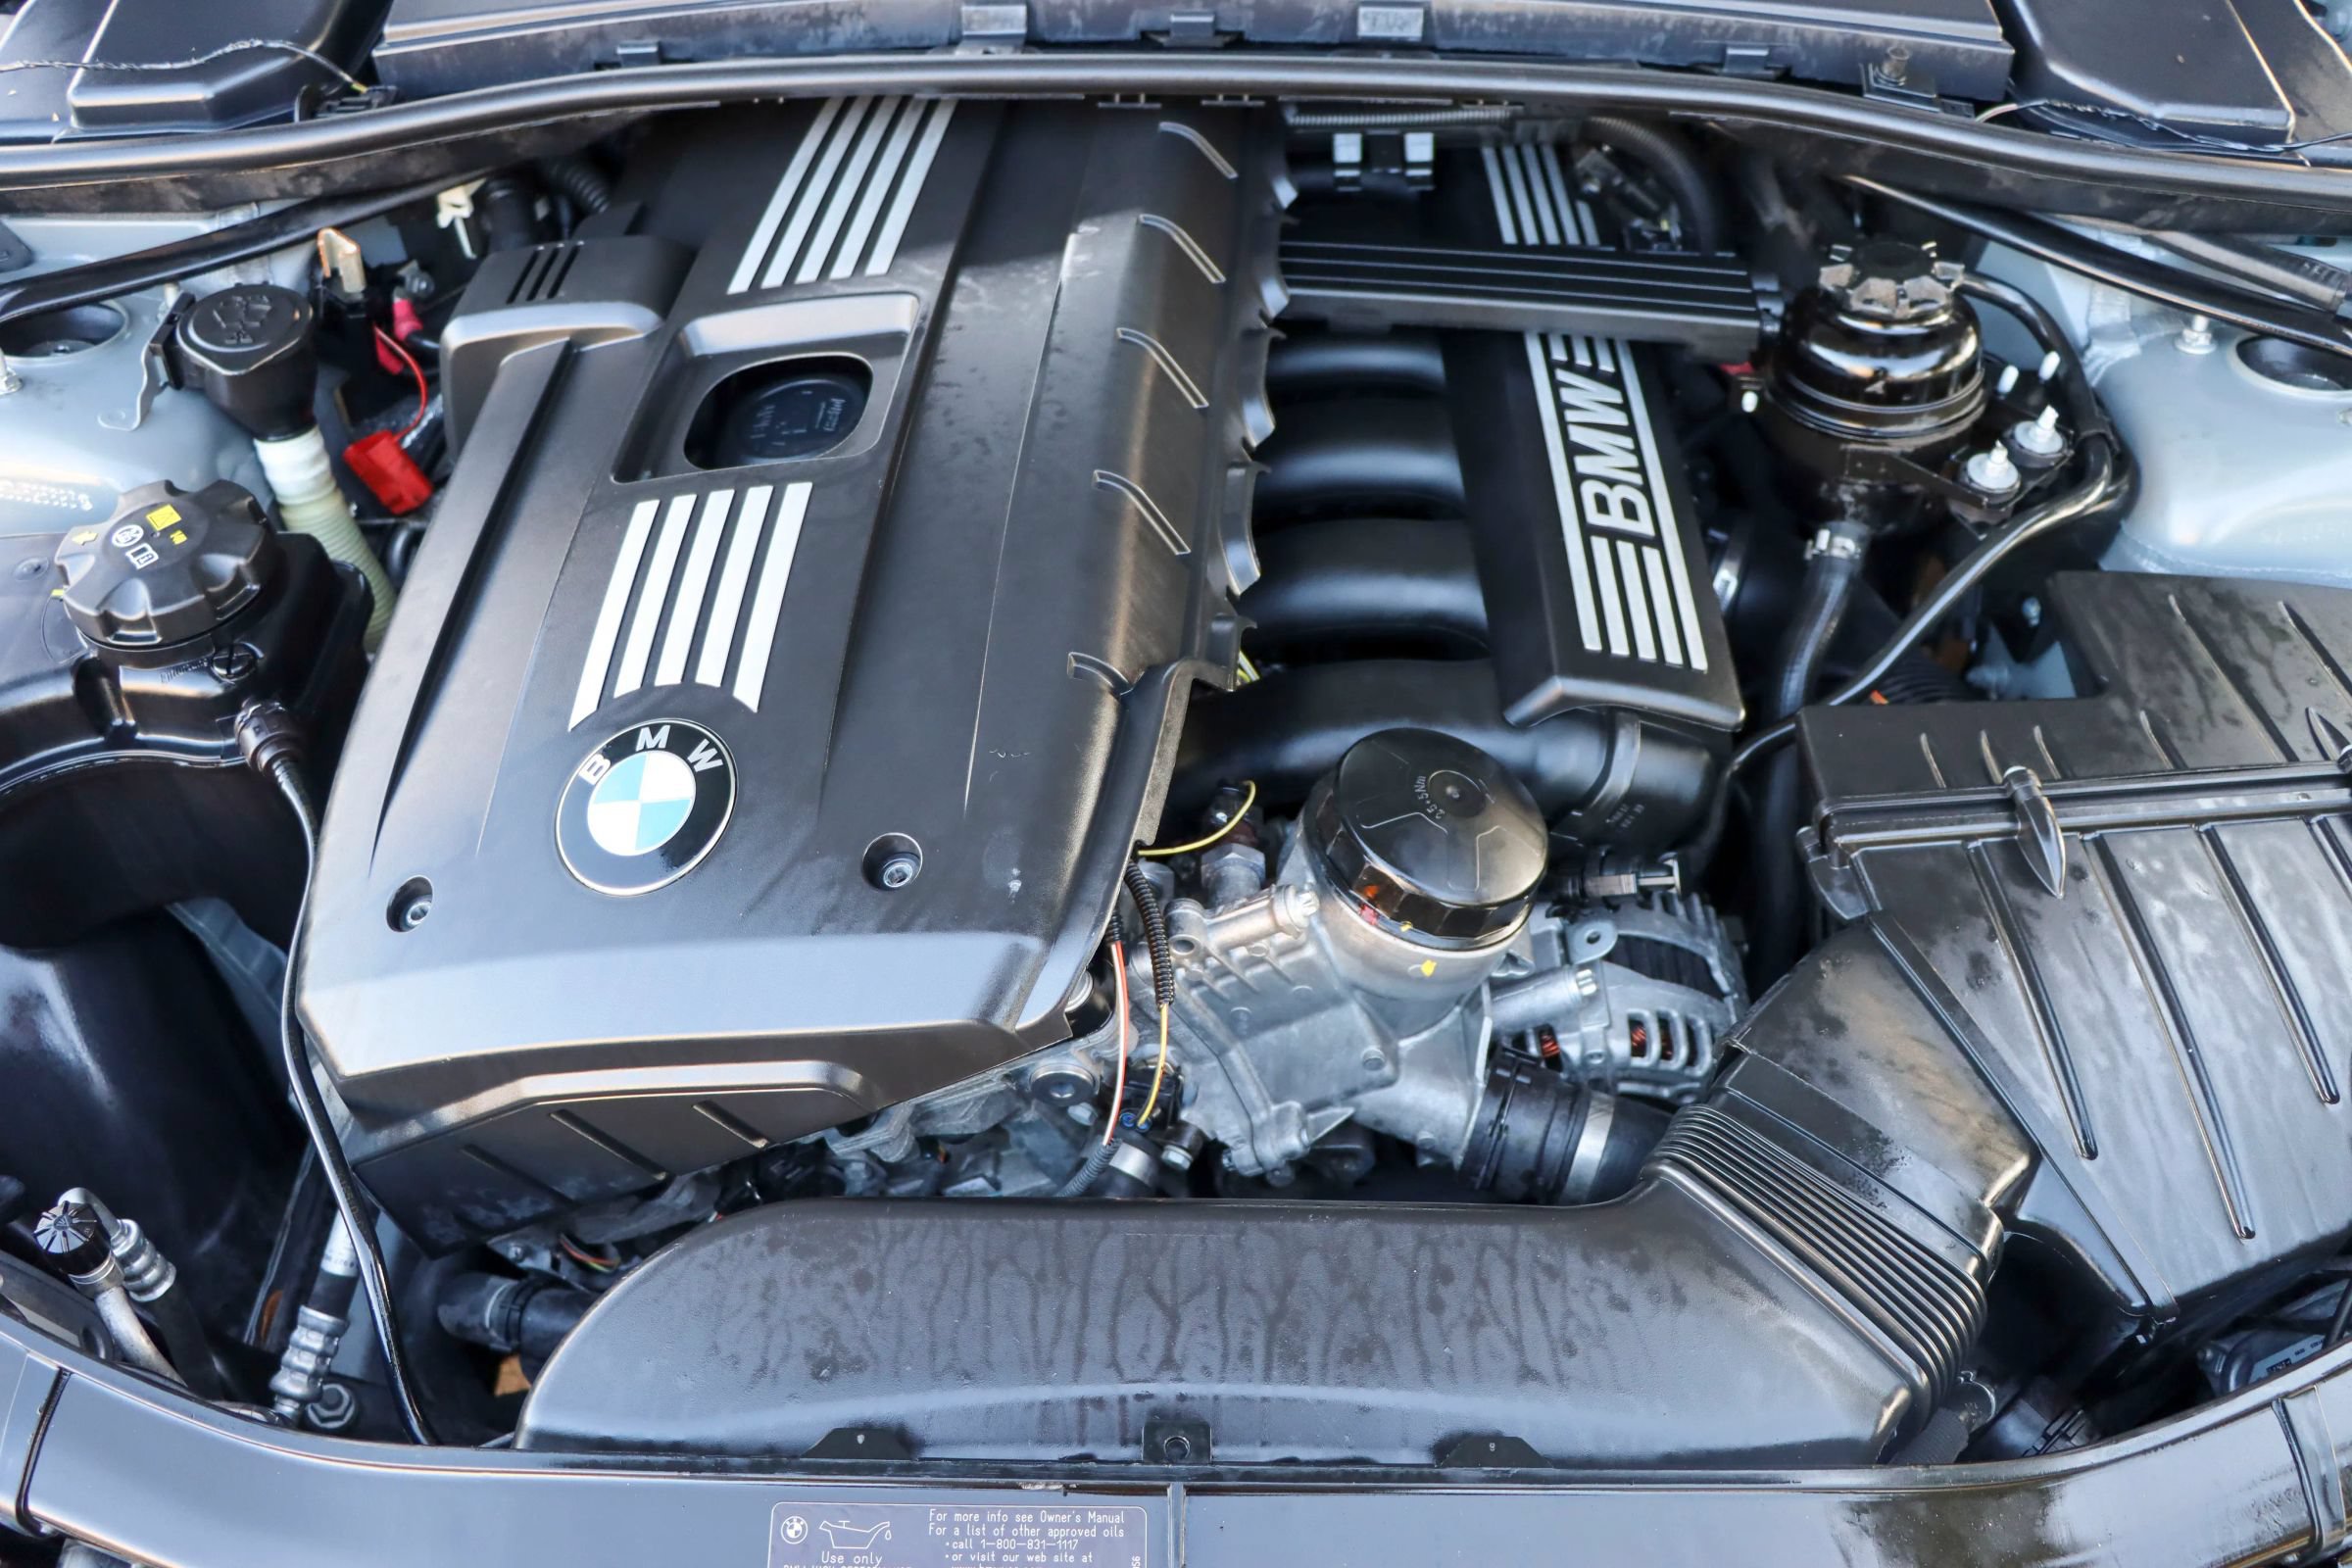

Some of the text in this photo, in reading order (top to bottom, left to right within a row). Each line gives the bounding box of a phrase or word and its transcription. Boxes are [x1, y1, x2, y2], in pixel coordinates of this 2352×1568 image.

[1554, 368, 1655, 538] BMW
[578, 724, 724, 786] BMW
[929, 1508, 1125, 1524] For more info see Owner's Manual
[928, 1522, 1125, 1540] For a list of other approved oils
[980, 1538, 1079, 1550] 1-800-831-1117
[821, 1551, 883, 1568] Use only
[969, 1551, 996, 1562] visit
[1002, 1554, 1020, 1563] our
[1026, 1551, 1047, 1563] web
[1053, 1551, 1075, 1563] site
[1081, 1551, 1093, 1563] at
